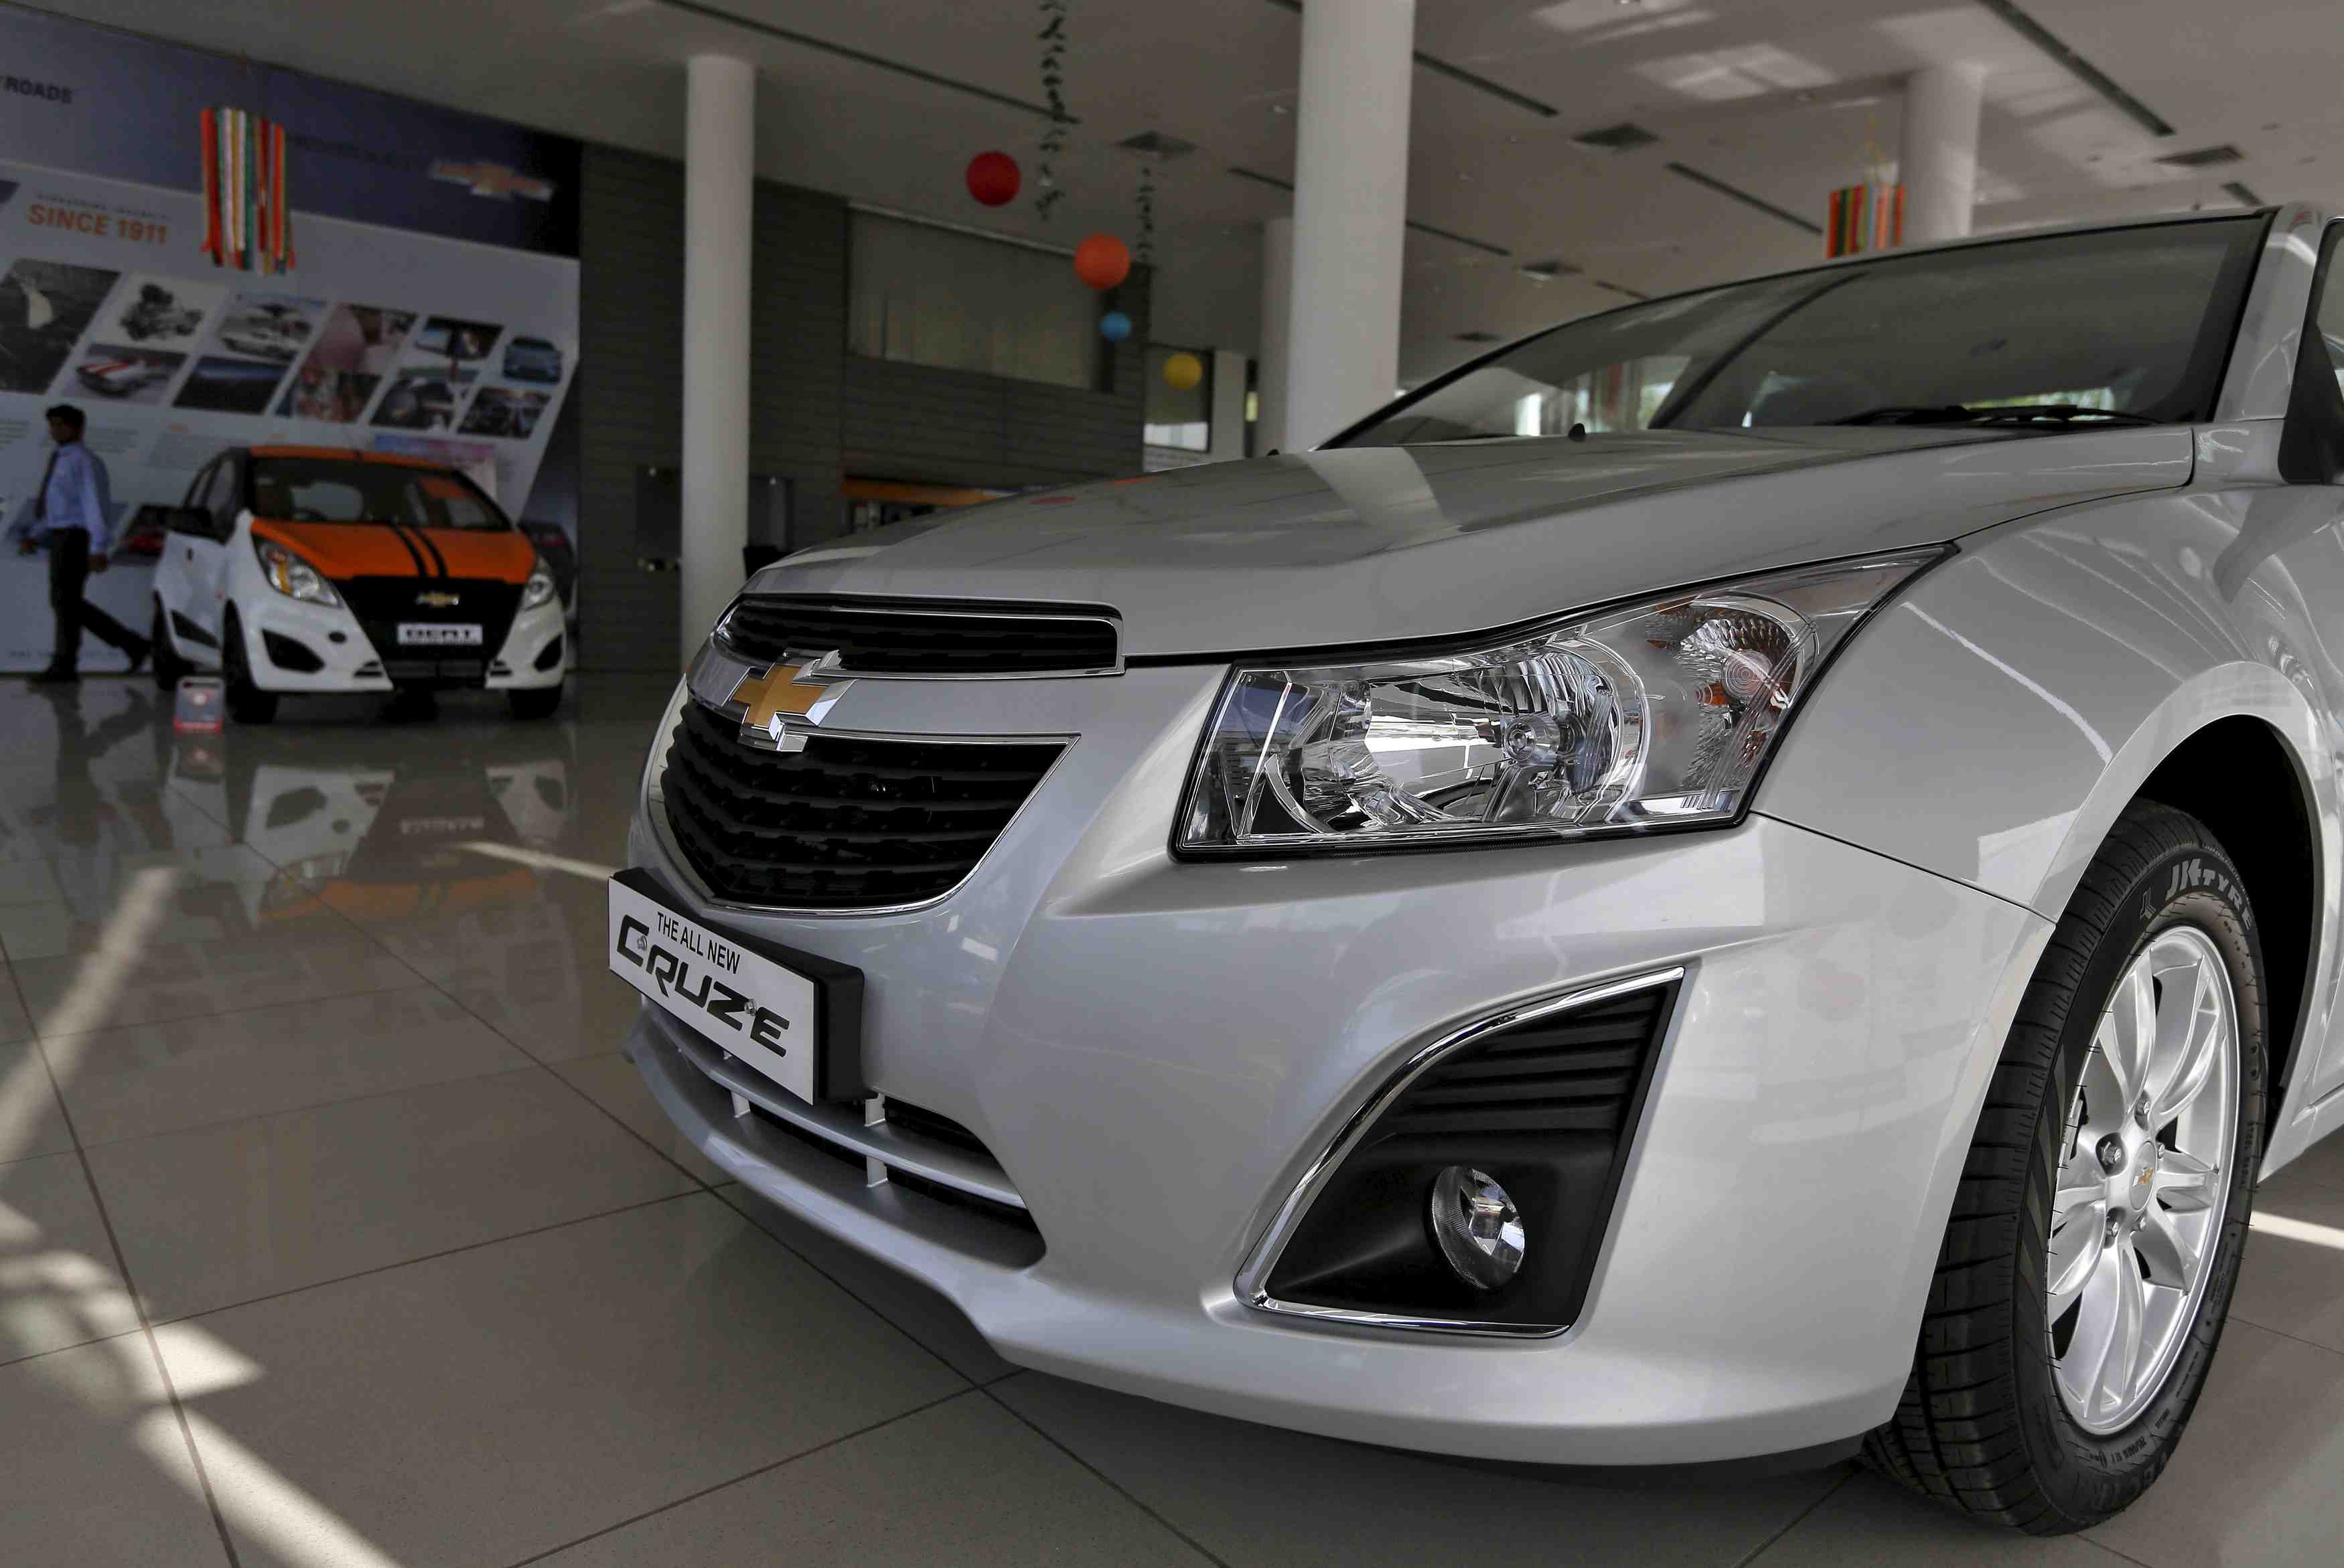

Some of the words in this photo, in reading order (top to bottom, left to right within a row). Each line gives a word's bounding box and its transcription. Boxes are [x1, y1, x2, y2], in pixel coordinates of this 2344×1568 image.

[4, 75, 73, 104] ROADS
[27, 203, 106, 236] SINCE
[117, 219, 168, 246] 1911
[2165, 858, 2201, 901] JK
[2202, 868, 2252, 931] TYRE
[657, 911, 679, 943] THE
[680, 927, 704, 957] ALL
[707, 939, 740, 974] NEW
[616, 914, 790, 1058] CRUZE
